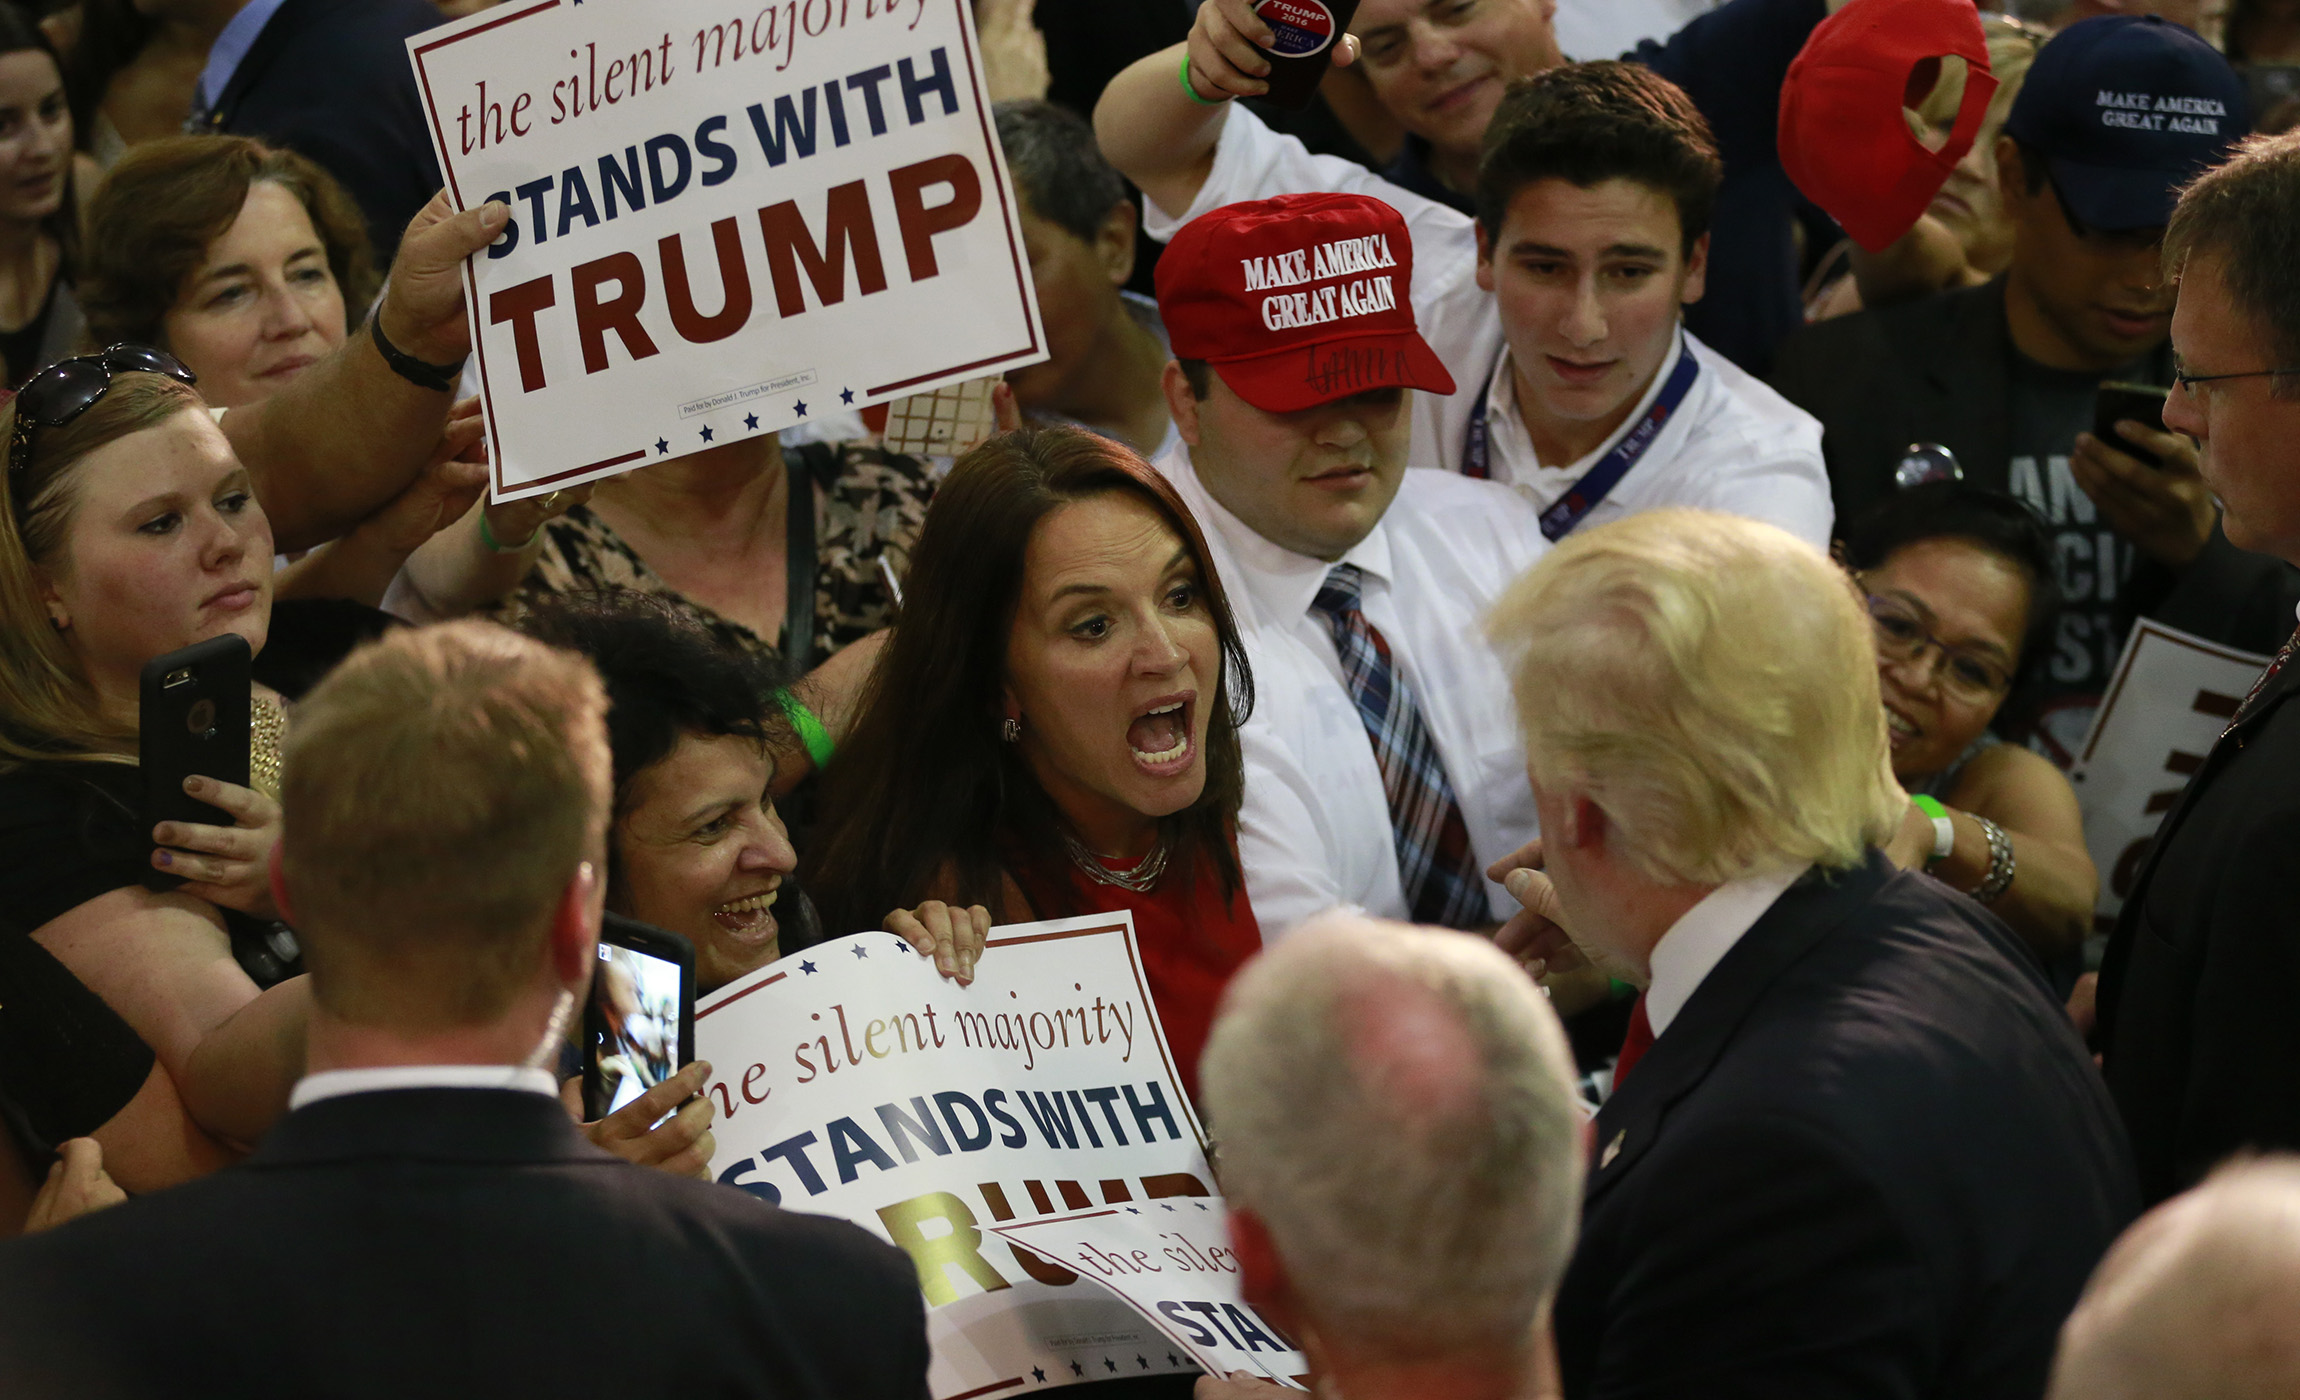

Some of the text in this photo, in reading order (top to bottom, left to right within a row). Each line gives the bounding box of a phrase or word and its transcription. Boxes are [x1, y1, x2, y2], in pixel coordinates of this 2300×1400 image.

[1273, 0, 1326, 21] TRUMP
[1281, 13, 1308, 26] 2016
[457, 81, 532, 156] the
[551, 33, 675, 125] silent
[2096, 89, 2228, 117] MAKE AMERICA
[2101, 109, 2219, 136] GREAT AGAIN
[483, 46, 959, 260] STANDS WITH
[489, 153, 983, 393] TRUMP
[1240, 233, 1397, 292] MAKE AMERICA
[1261, 275, 1397, 332] GREAT AGAIN
[739, 388, 760, 399] Trump
[760, 383, 770, 393] for
[698, 982, 1133, 1130] he silent majority
[716, 1081, 1183, 1208] STANDS WITH
[1077, 1232, 1241, 1276] the sile
